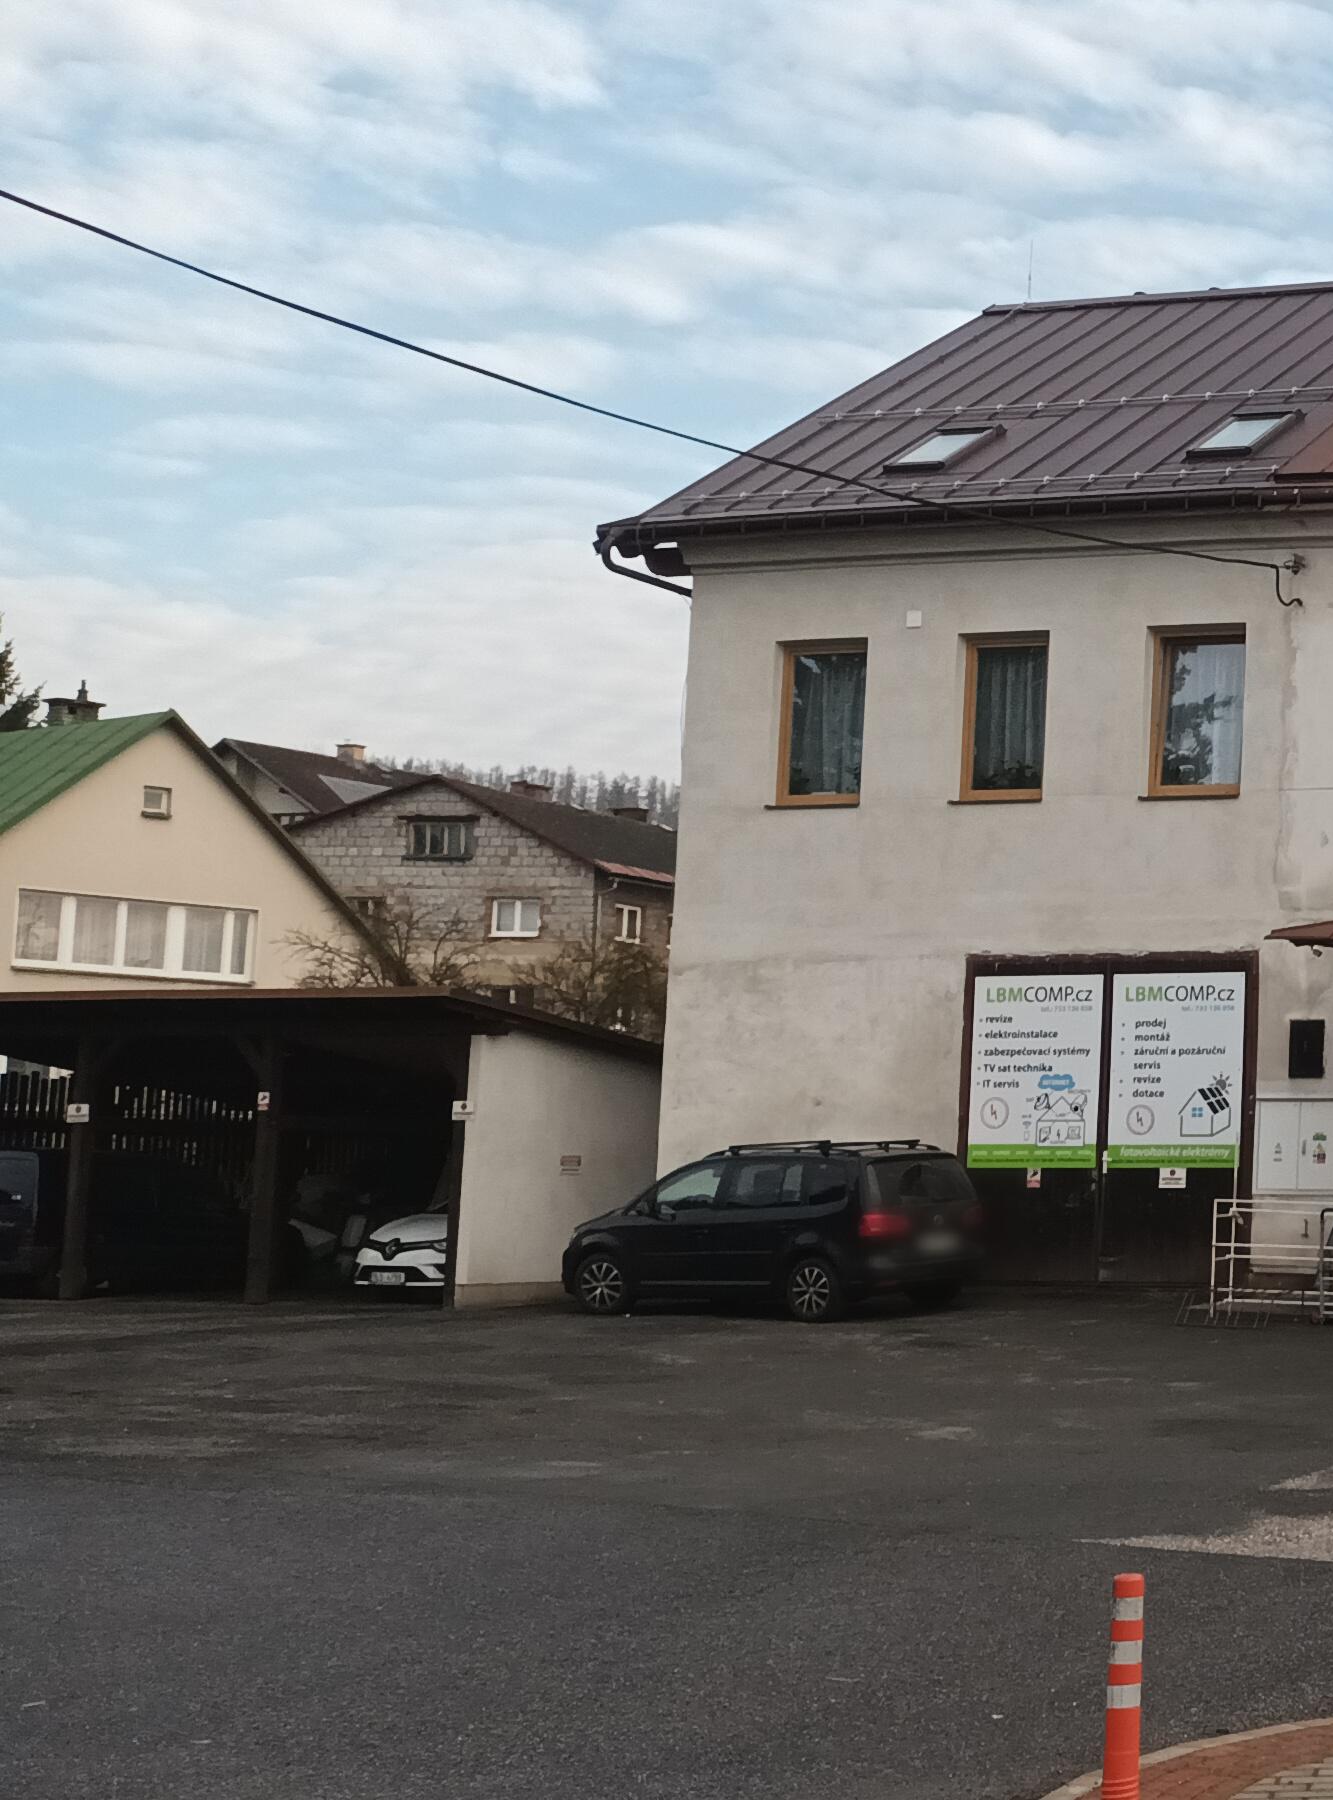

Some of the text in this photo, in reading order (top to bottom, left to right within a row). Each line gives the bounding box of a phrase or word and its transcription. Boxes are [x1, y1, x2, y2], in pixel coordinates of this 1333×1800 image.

[986, 986, 1093, 1003] LBMCOMP.cz
[1125, 985, 1235, 1002] LBMCOMP.cz
[985, 1014, 1013, 1023] revize
[1135, 1018, 1167, 1029] prodej
[985, 1030, 1058, 1039] elektroinstalace
[1134, 1033, 1171, 1042] montáž
[983, 1046, 1091, 1057] zabezpečovací systémy
[1134, 1046, 1169, 1055] záruční
[1179, 1046, 1226, 1057] pozáruční
[983, 1064, 996, 1073] TV
[1013, 1063, 1053, 1072] technika
[1133, 1061, 1161, 1070] servis
[982, 1080, 1020, 1088] IT servis
[1133, 1075, 1162, 1084] revize
[1132, 1088, 1165, 1098] dotace
